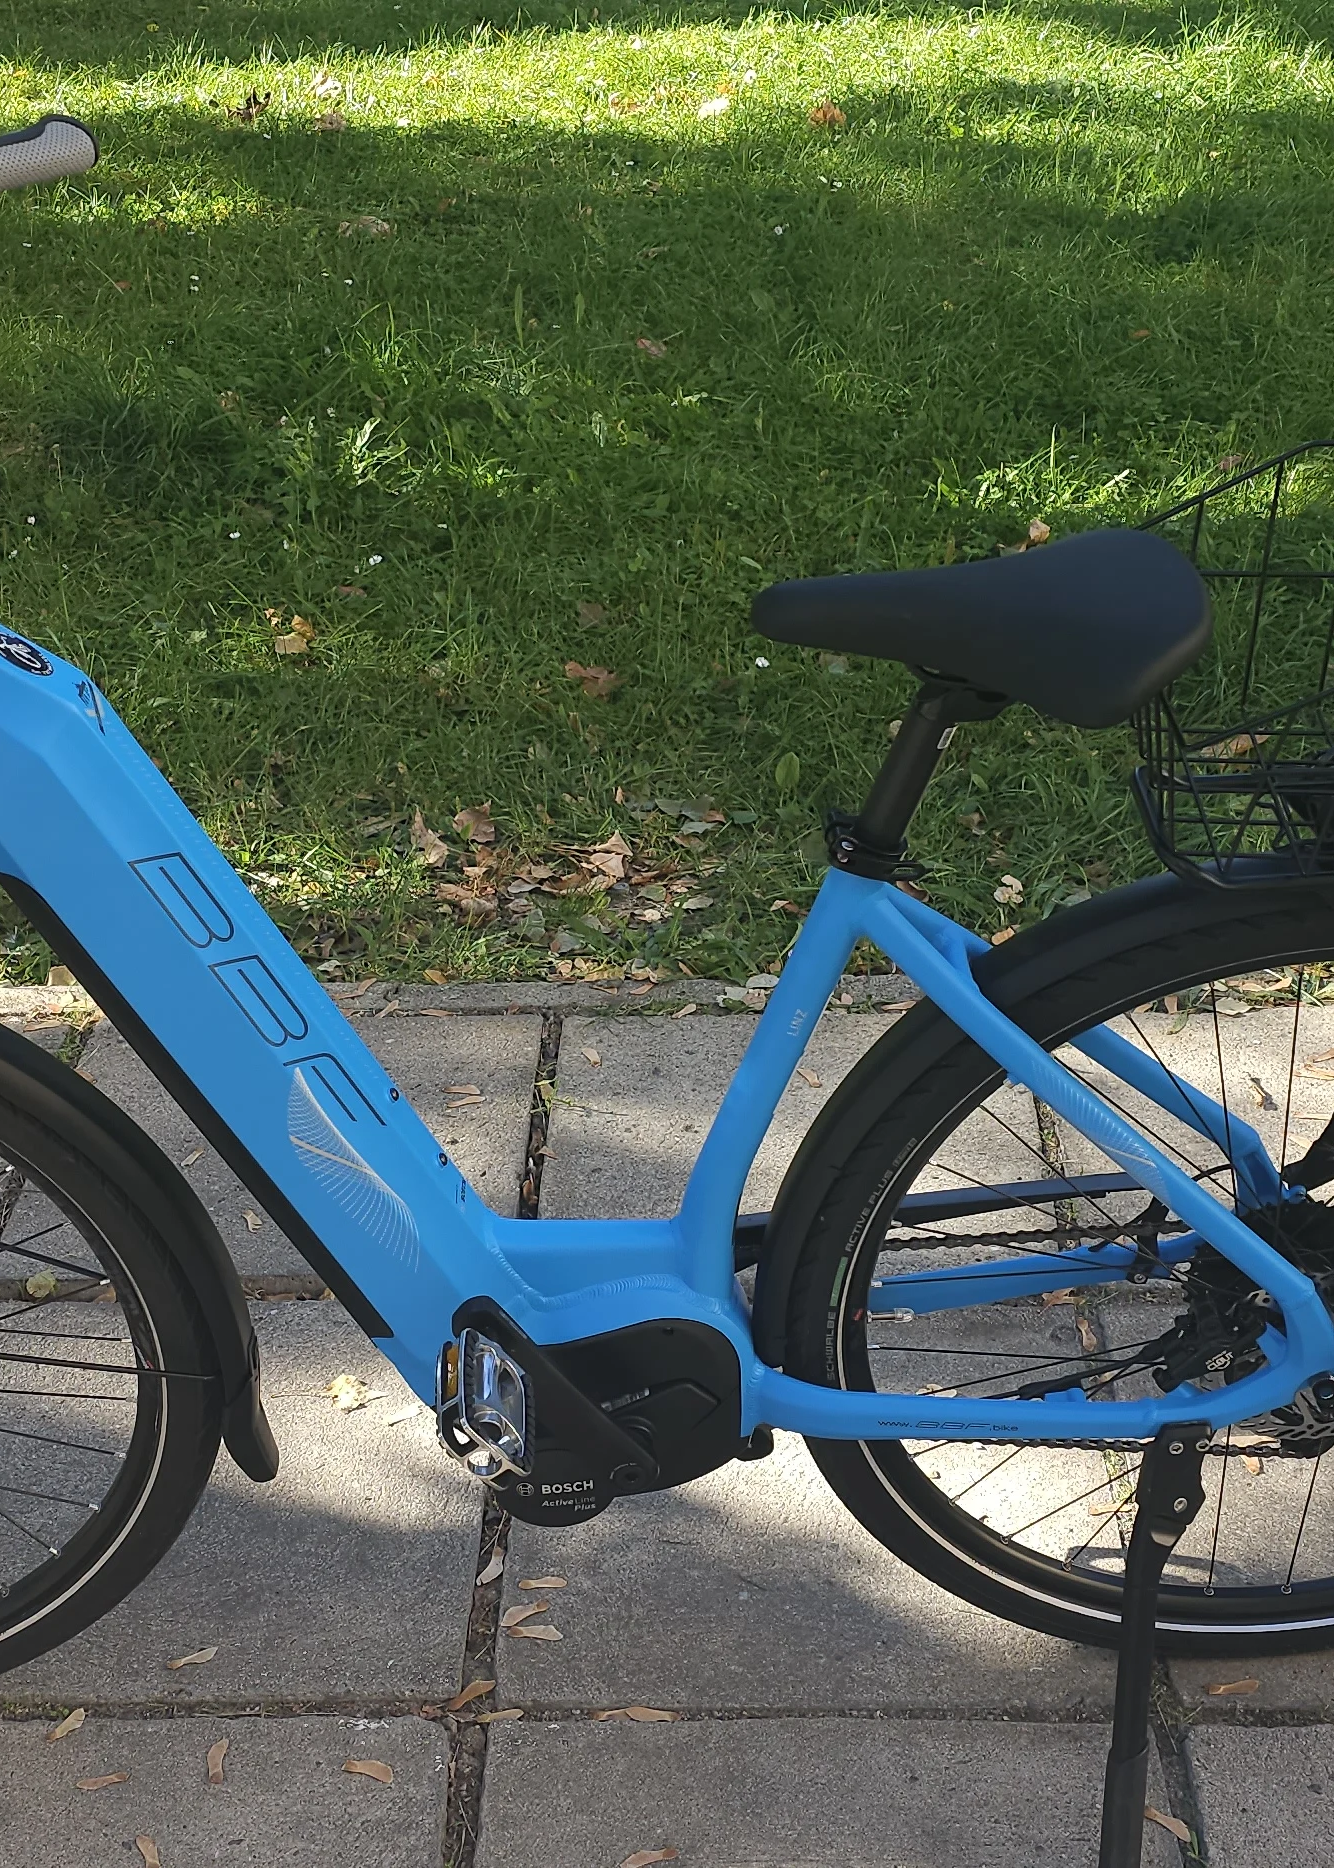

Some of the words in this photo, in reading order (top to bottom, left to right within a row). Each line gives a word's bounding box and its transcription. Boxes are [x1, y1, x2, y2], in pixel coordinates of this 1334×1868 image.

[128, 851, 387, 1126] BBF
[825, 1311, 837, 1381] SCHWALBE
[845, 1207, 871, 1252] ACTIVE
[868, 1169, 893, 1204] PLUS
[541, 1479, 594, 1495] BOSCH
[574, 1503, 596, 1512] Plus
